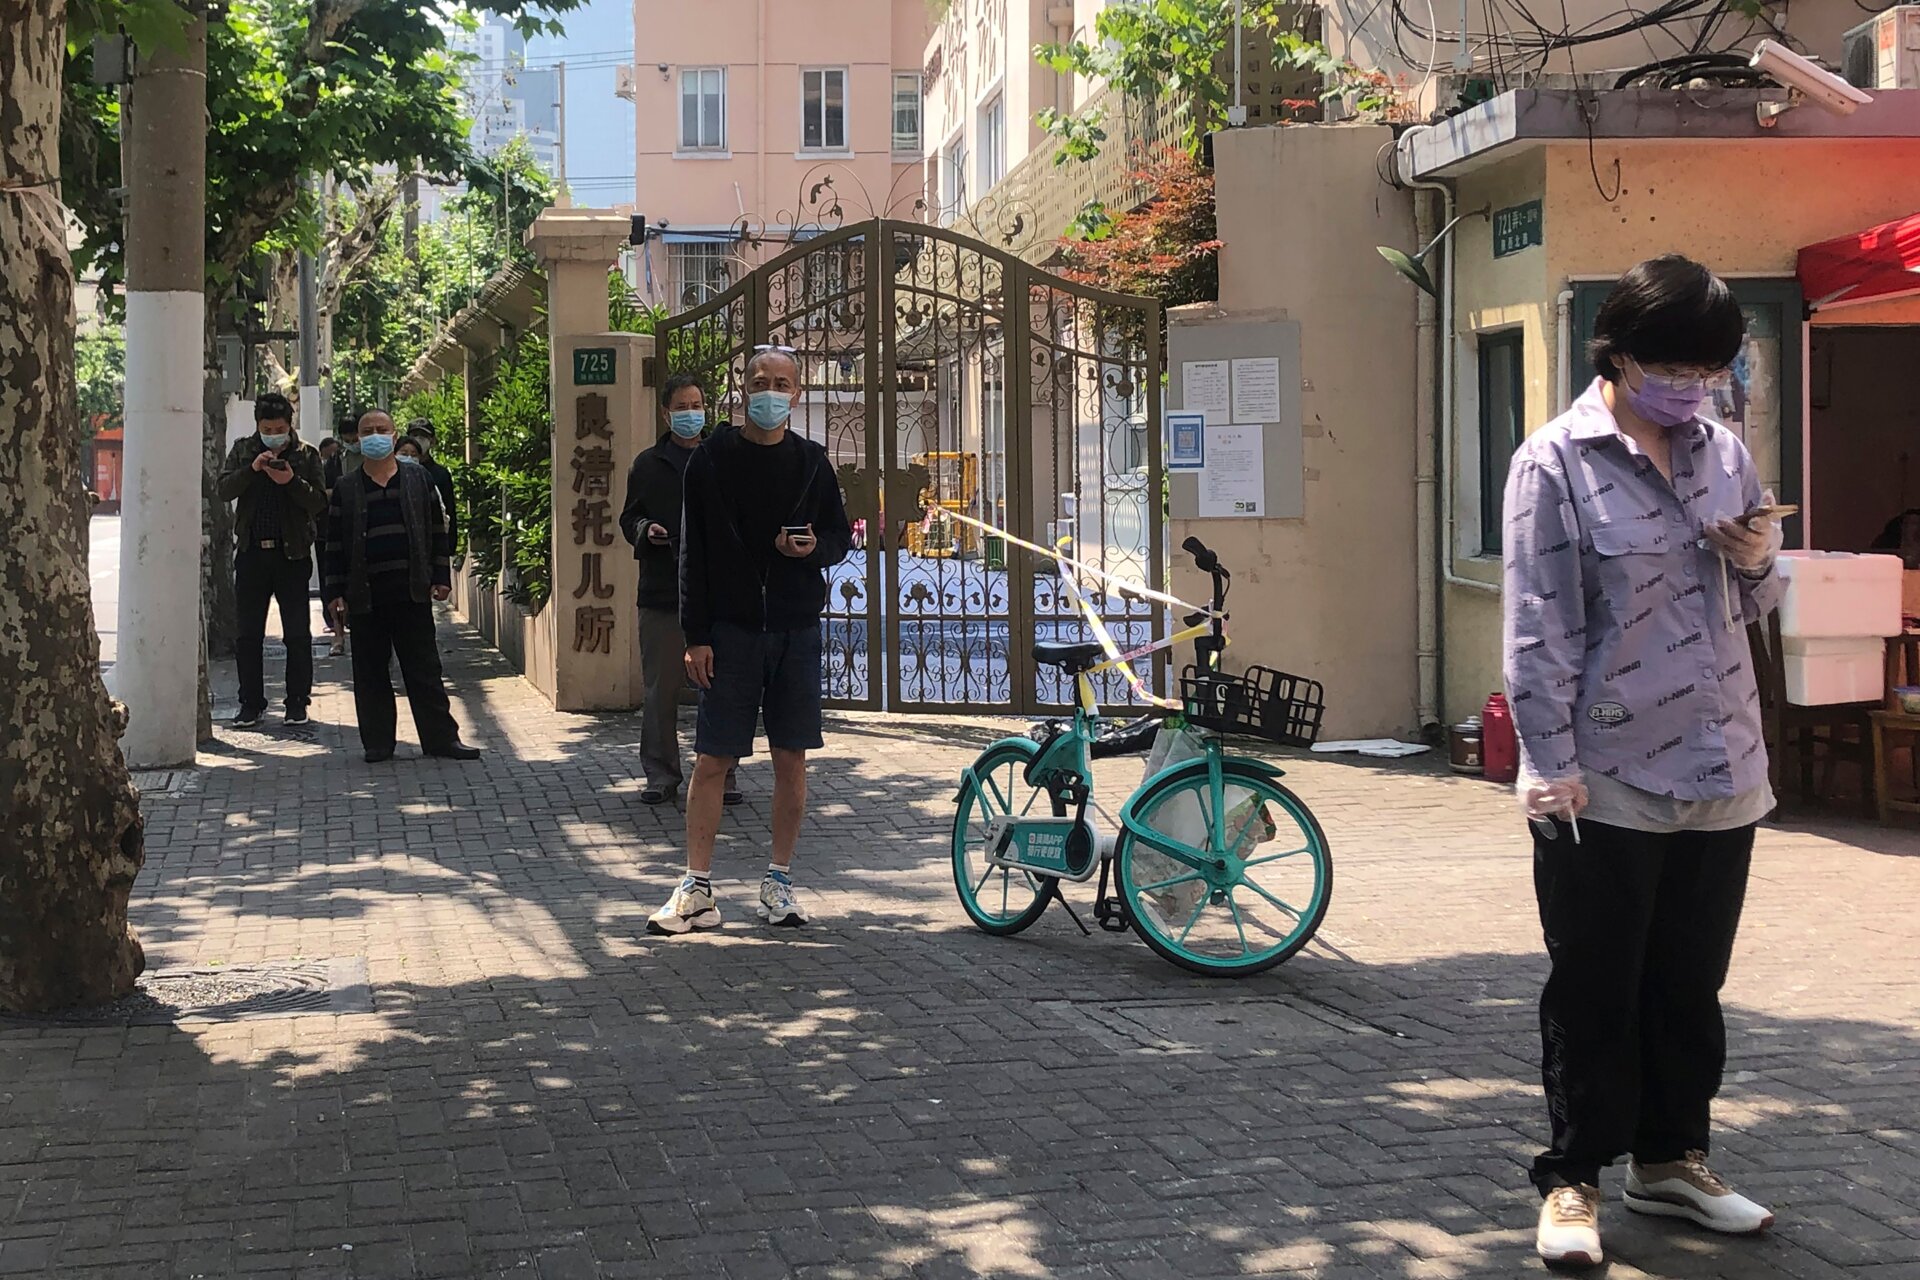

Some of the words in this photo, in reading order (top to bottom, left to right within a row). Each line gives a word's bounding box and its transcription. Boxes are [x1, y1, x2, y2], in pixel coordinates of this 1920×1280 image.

[580, 353, 609, 372] 725
[1666, 631, 1702, 653] LI-NING
[1604, 660, 1641, 682] LI-NING
[1657, 684, 1695, 707] LI-NING
[1646, 736, 1683, 759] LI-NING
